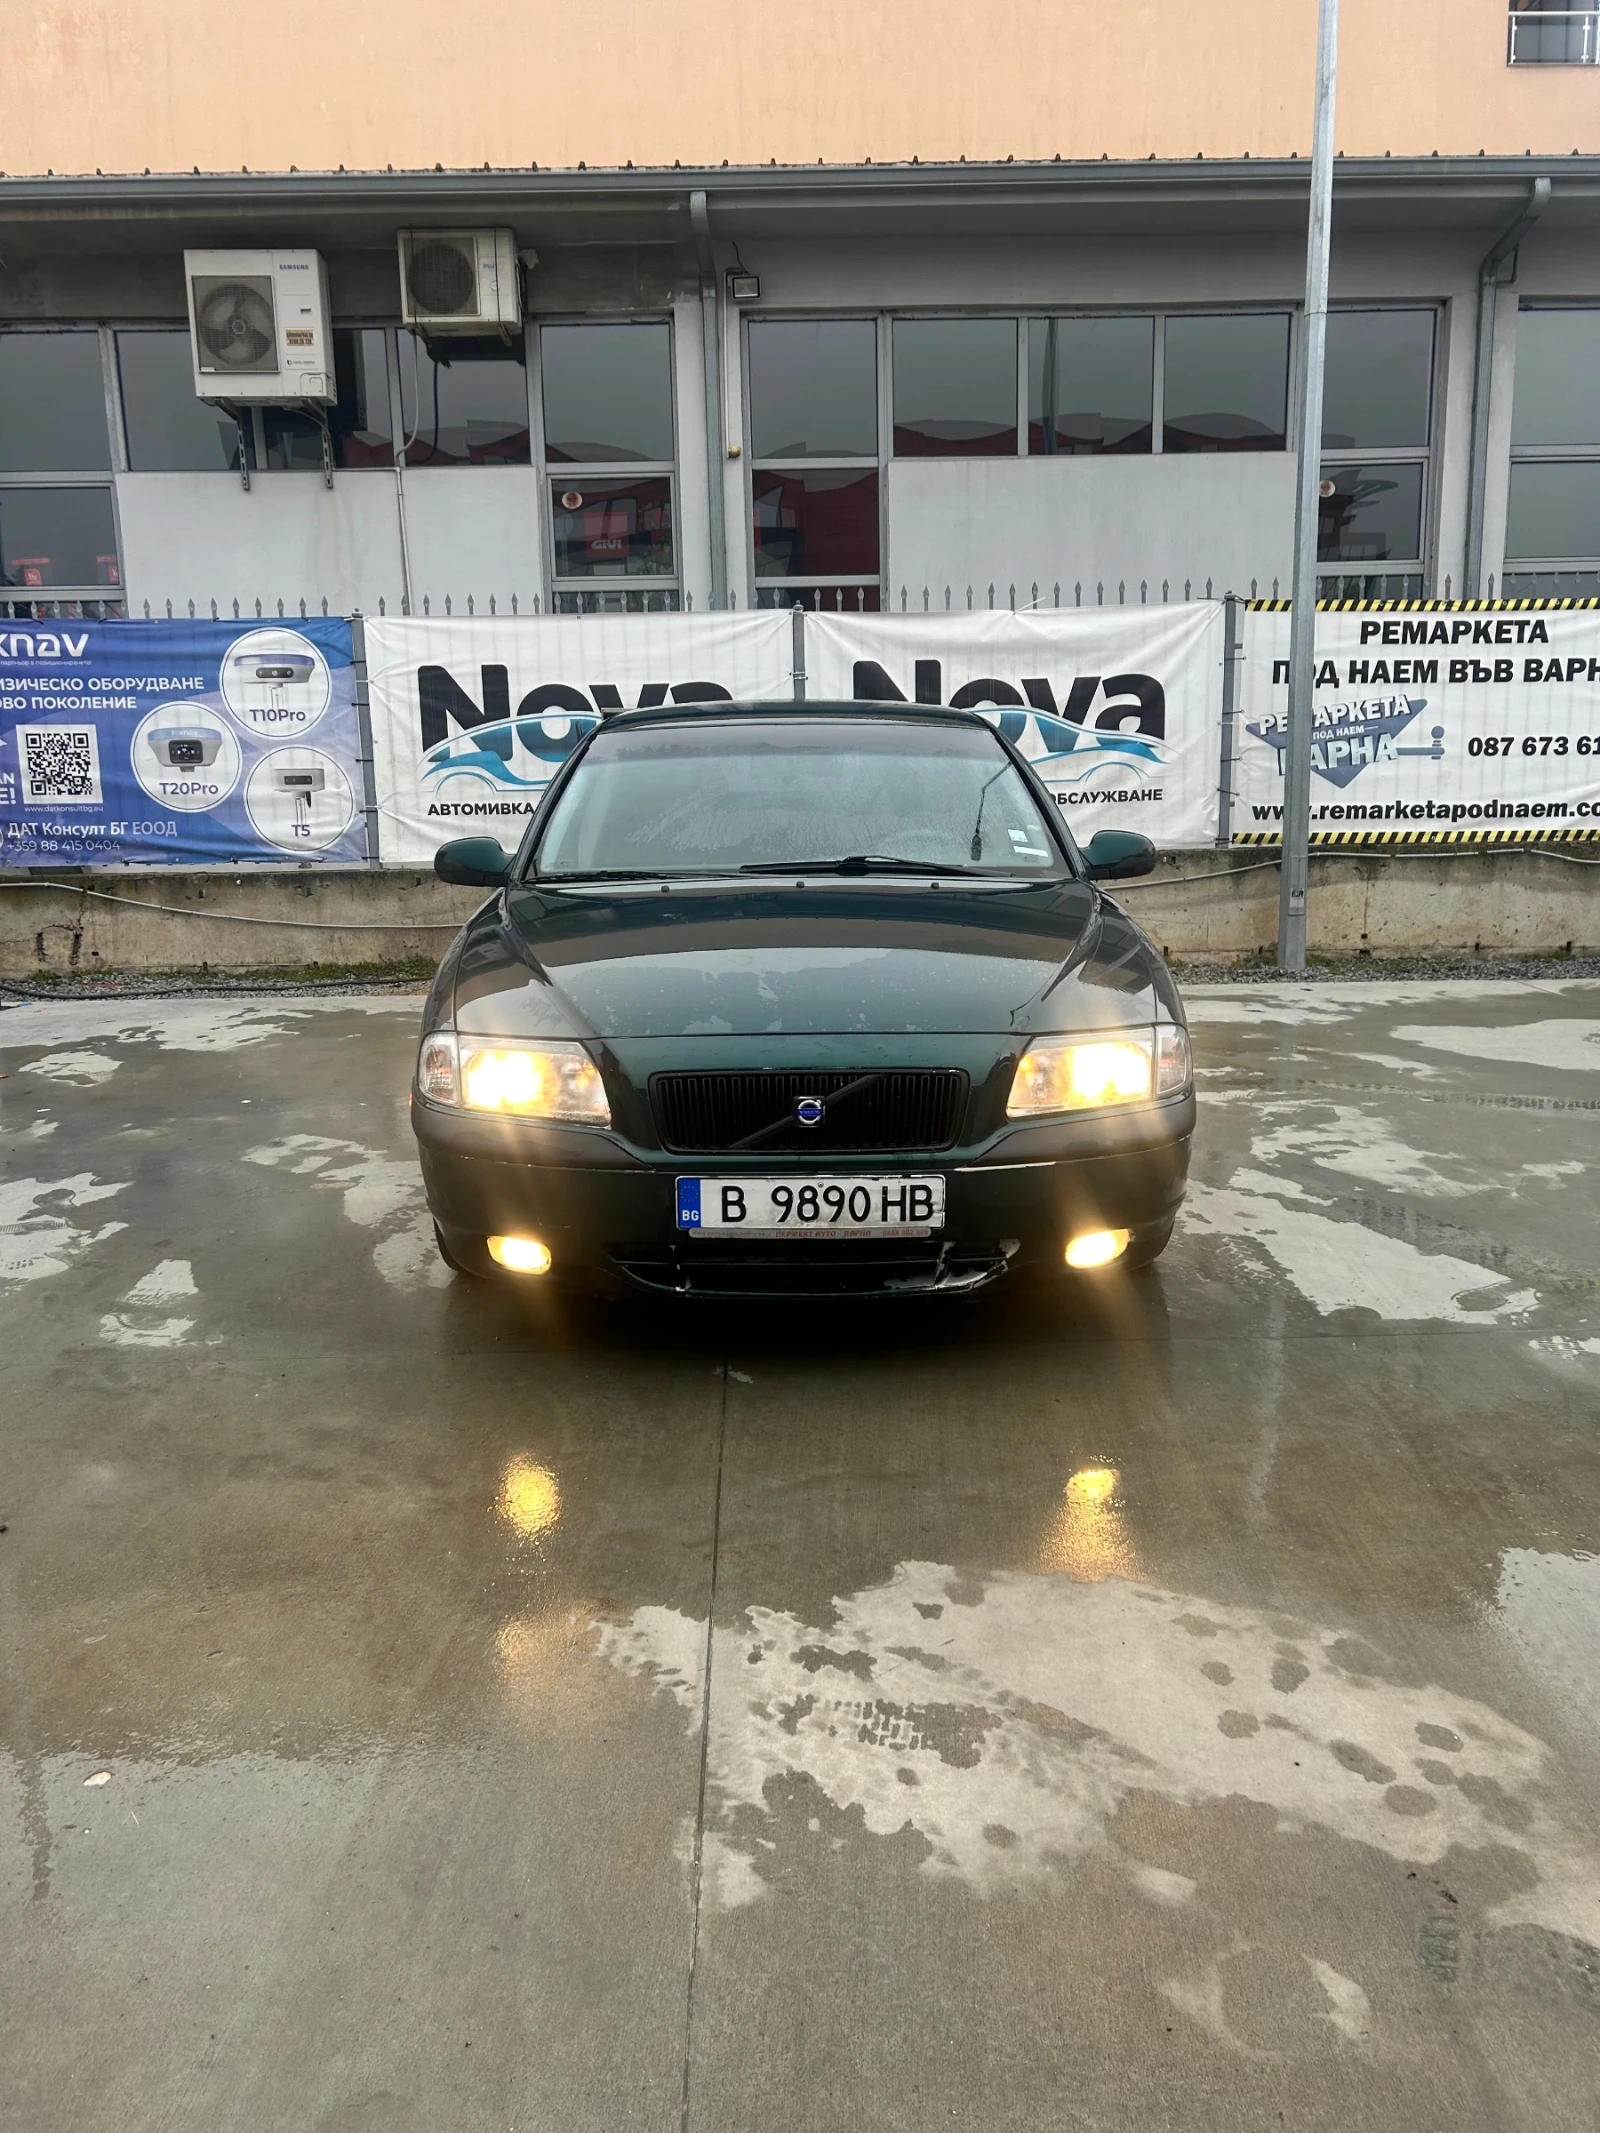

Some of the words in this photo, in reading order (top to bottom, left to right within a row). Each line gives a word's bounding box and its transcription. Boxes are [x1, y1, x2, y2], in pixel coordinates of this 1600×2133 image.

[1360, 619, 1549, 645] РЕМАРКЕТА
[1272, 660, 1339, 688] ПД
[1348, 660, 1438, 684] НАЕМ
[1449, 659, 1514, 683] ВЪВ
[1523, 657, 1600, 682] ВАРН
[88, 677, 204, 692] ОБОРУДВАНЕ
[0, 696, 27, 709] ВО
[31, 696, 137, 709] ПОКОЛЕНИЕ
[249, 709, 306, 722] T10Pro
[1258, 694, 1412, 736] РЕАРКЕТА
[1312, 731, 1335, 740] ПОД
[1336, 725, 1364, 737] НАЕМ
[1468, 737, 1514, 756] 087
[1522, 736, 1569, 756] 673
[1277, 733, 1399, 777] АРНА
[159, 782, 219, 795] T20Pro
[24, 805, 104, 813] www.datkonsultbg.eu
[428, 802, 535, 816] АВТОМИВКА
[1252, 799, 1600, 823] ww.remarketapodnaem.co
[8, 822, 38, 838] ДАТ
[42, 822, 107, 838] Консулт
[110, 822, 128, 836] БГ
[132, 821, 178, 837] ЕООД
[291, 824, 311, 837] T5
[8, 840, 37, 852] +359
[40, 840, 58, 852] 88
[61, 840, 83, 851] 415
[85, 839, 121, 851] 0404
[682, 1210, 699, 1222] BG
